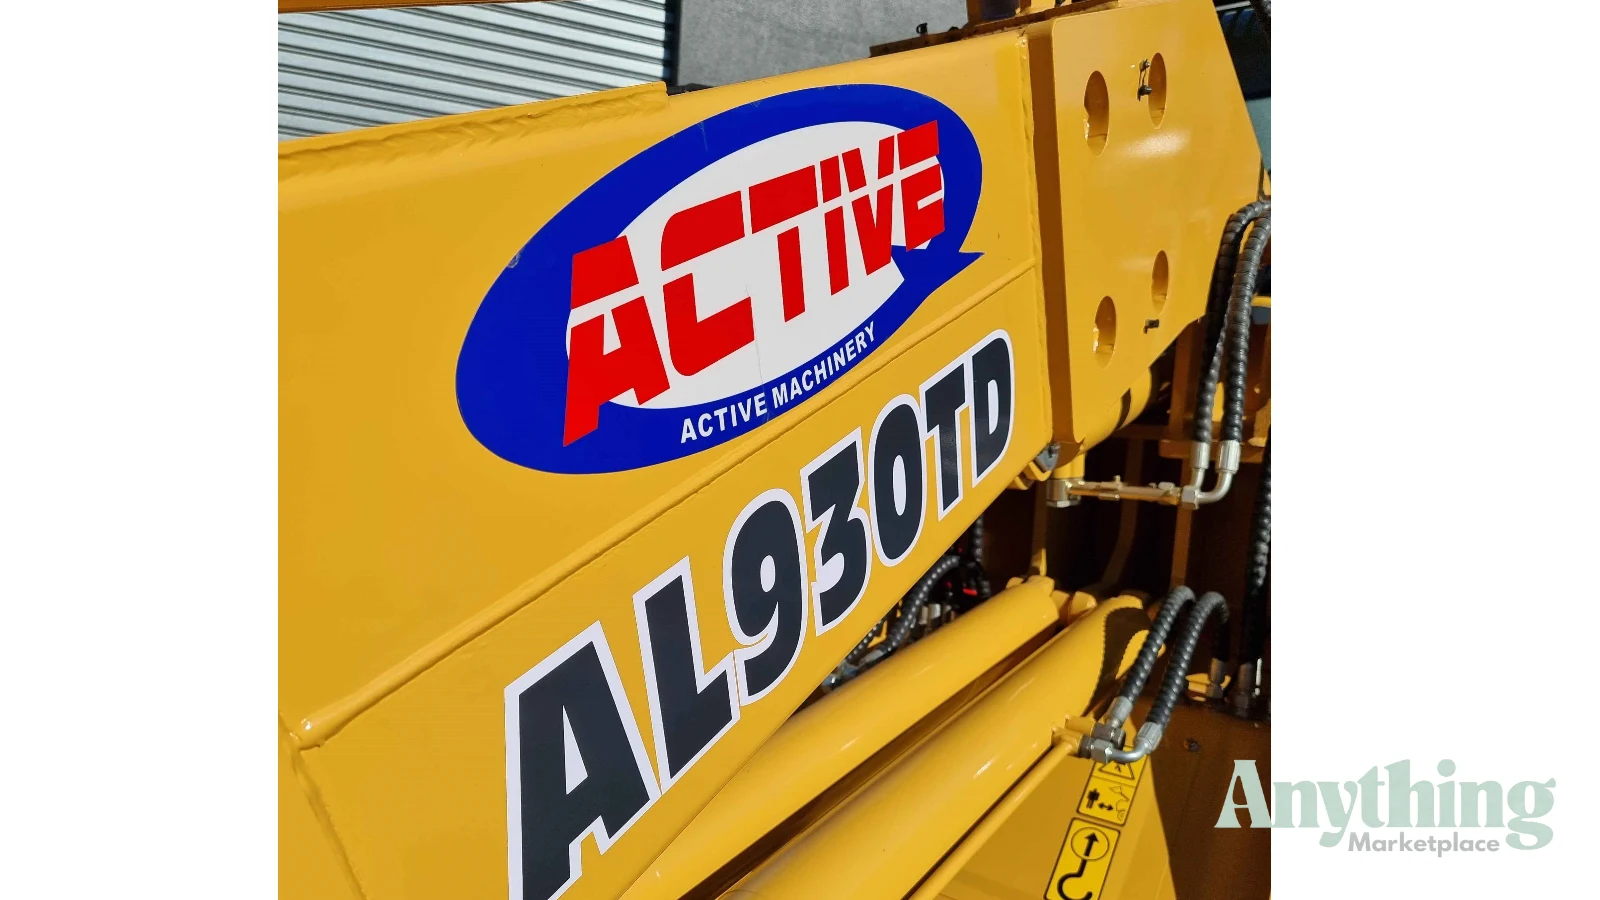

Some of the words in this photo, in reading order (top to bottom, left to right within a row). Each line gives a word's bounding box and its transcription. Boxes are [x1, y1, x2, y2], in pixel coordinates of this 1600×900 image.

[563, 120, 945, 447] ACTIVE
[680, 392, 768, 444] ACTIVE
[772, 321, 876, 409] MACHINERY
[504, 329, 1015, 900] AL930TD
